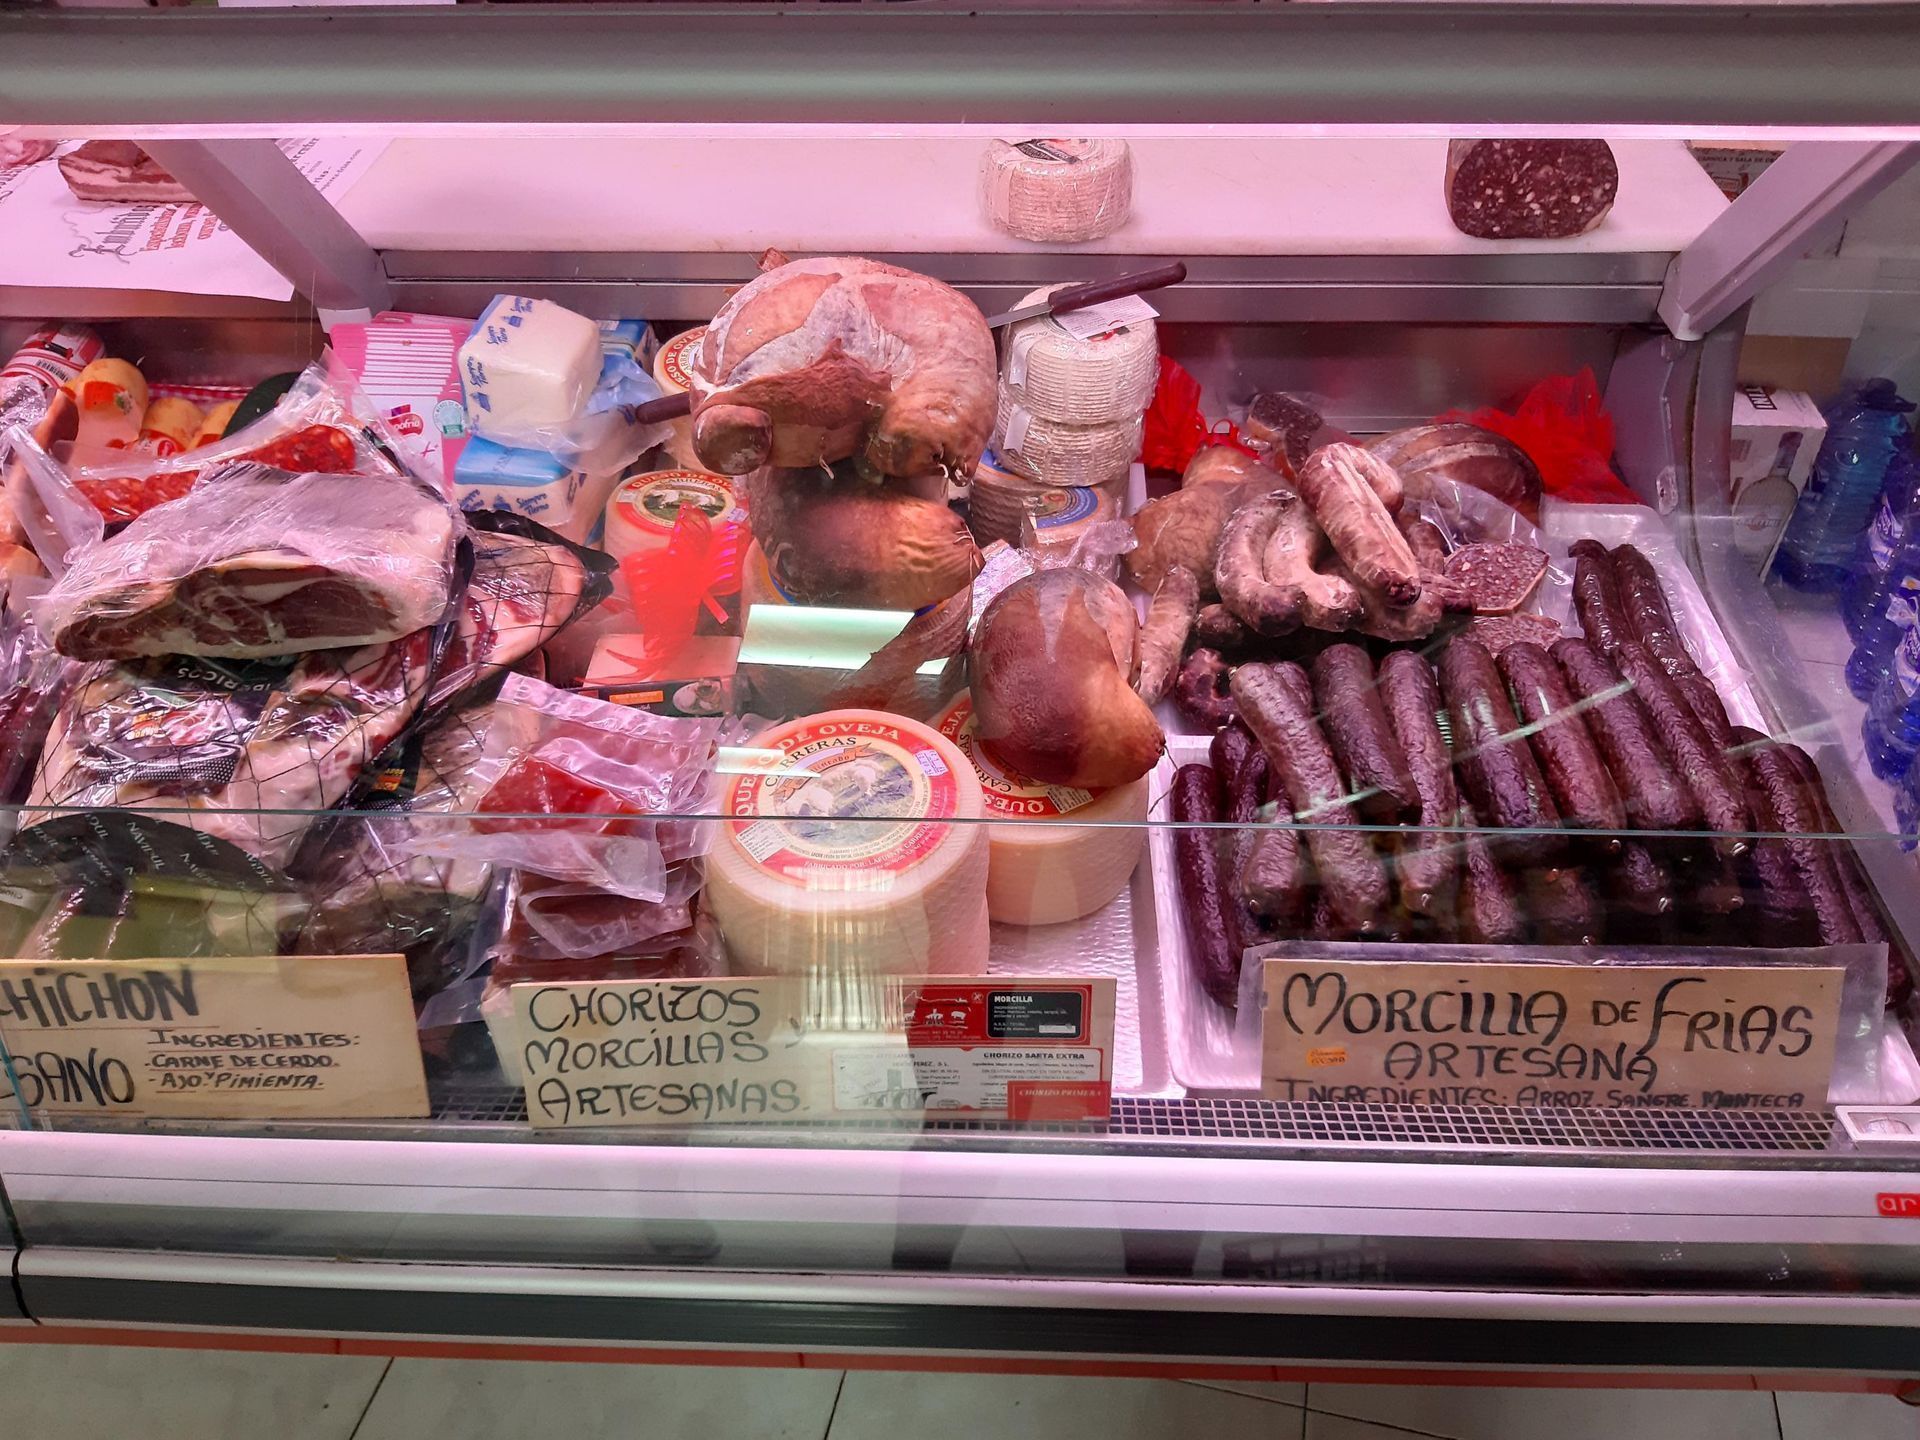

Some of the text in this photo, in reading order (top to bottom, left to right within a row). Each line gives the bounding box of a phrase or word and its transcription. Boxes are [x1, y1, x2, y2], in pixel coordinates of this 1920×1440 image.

[665, 351, 677, 365] DE
[776, 728, 811, 751] DE
[819, 723, 901, 741] OVEJA
[994, 995, 1033, 1003] MORCILLA
[1591, 1000, 1641, 1027] DE
[229, 1054, 260, 1068] DE
[1383, 1041, 1658, 1093] ARTESANA
